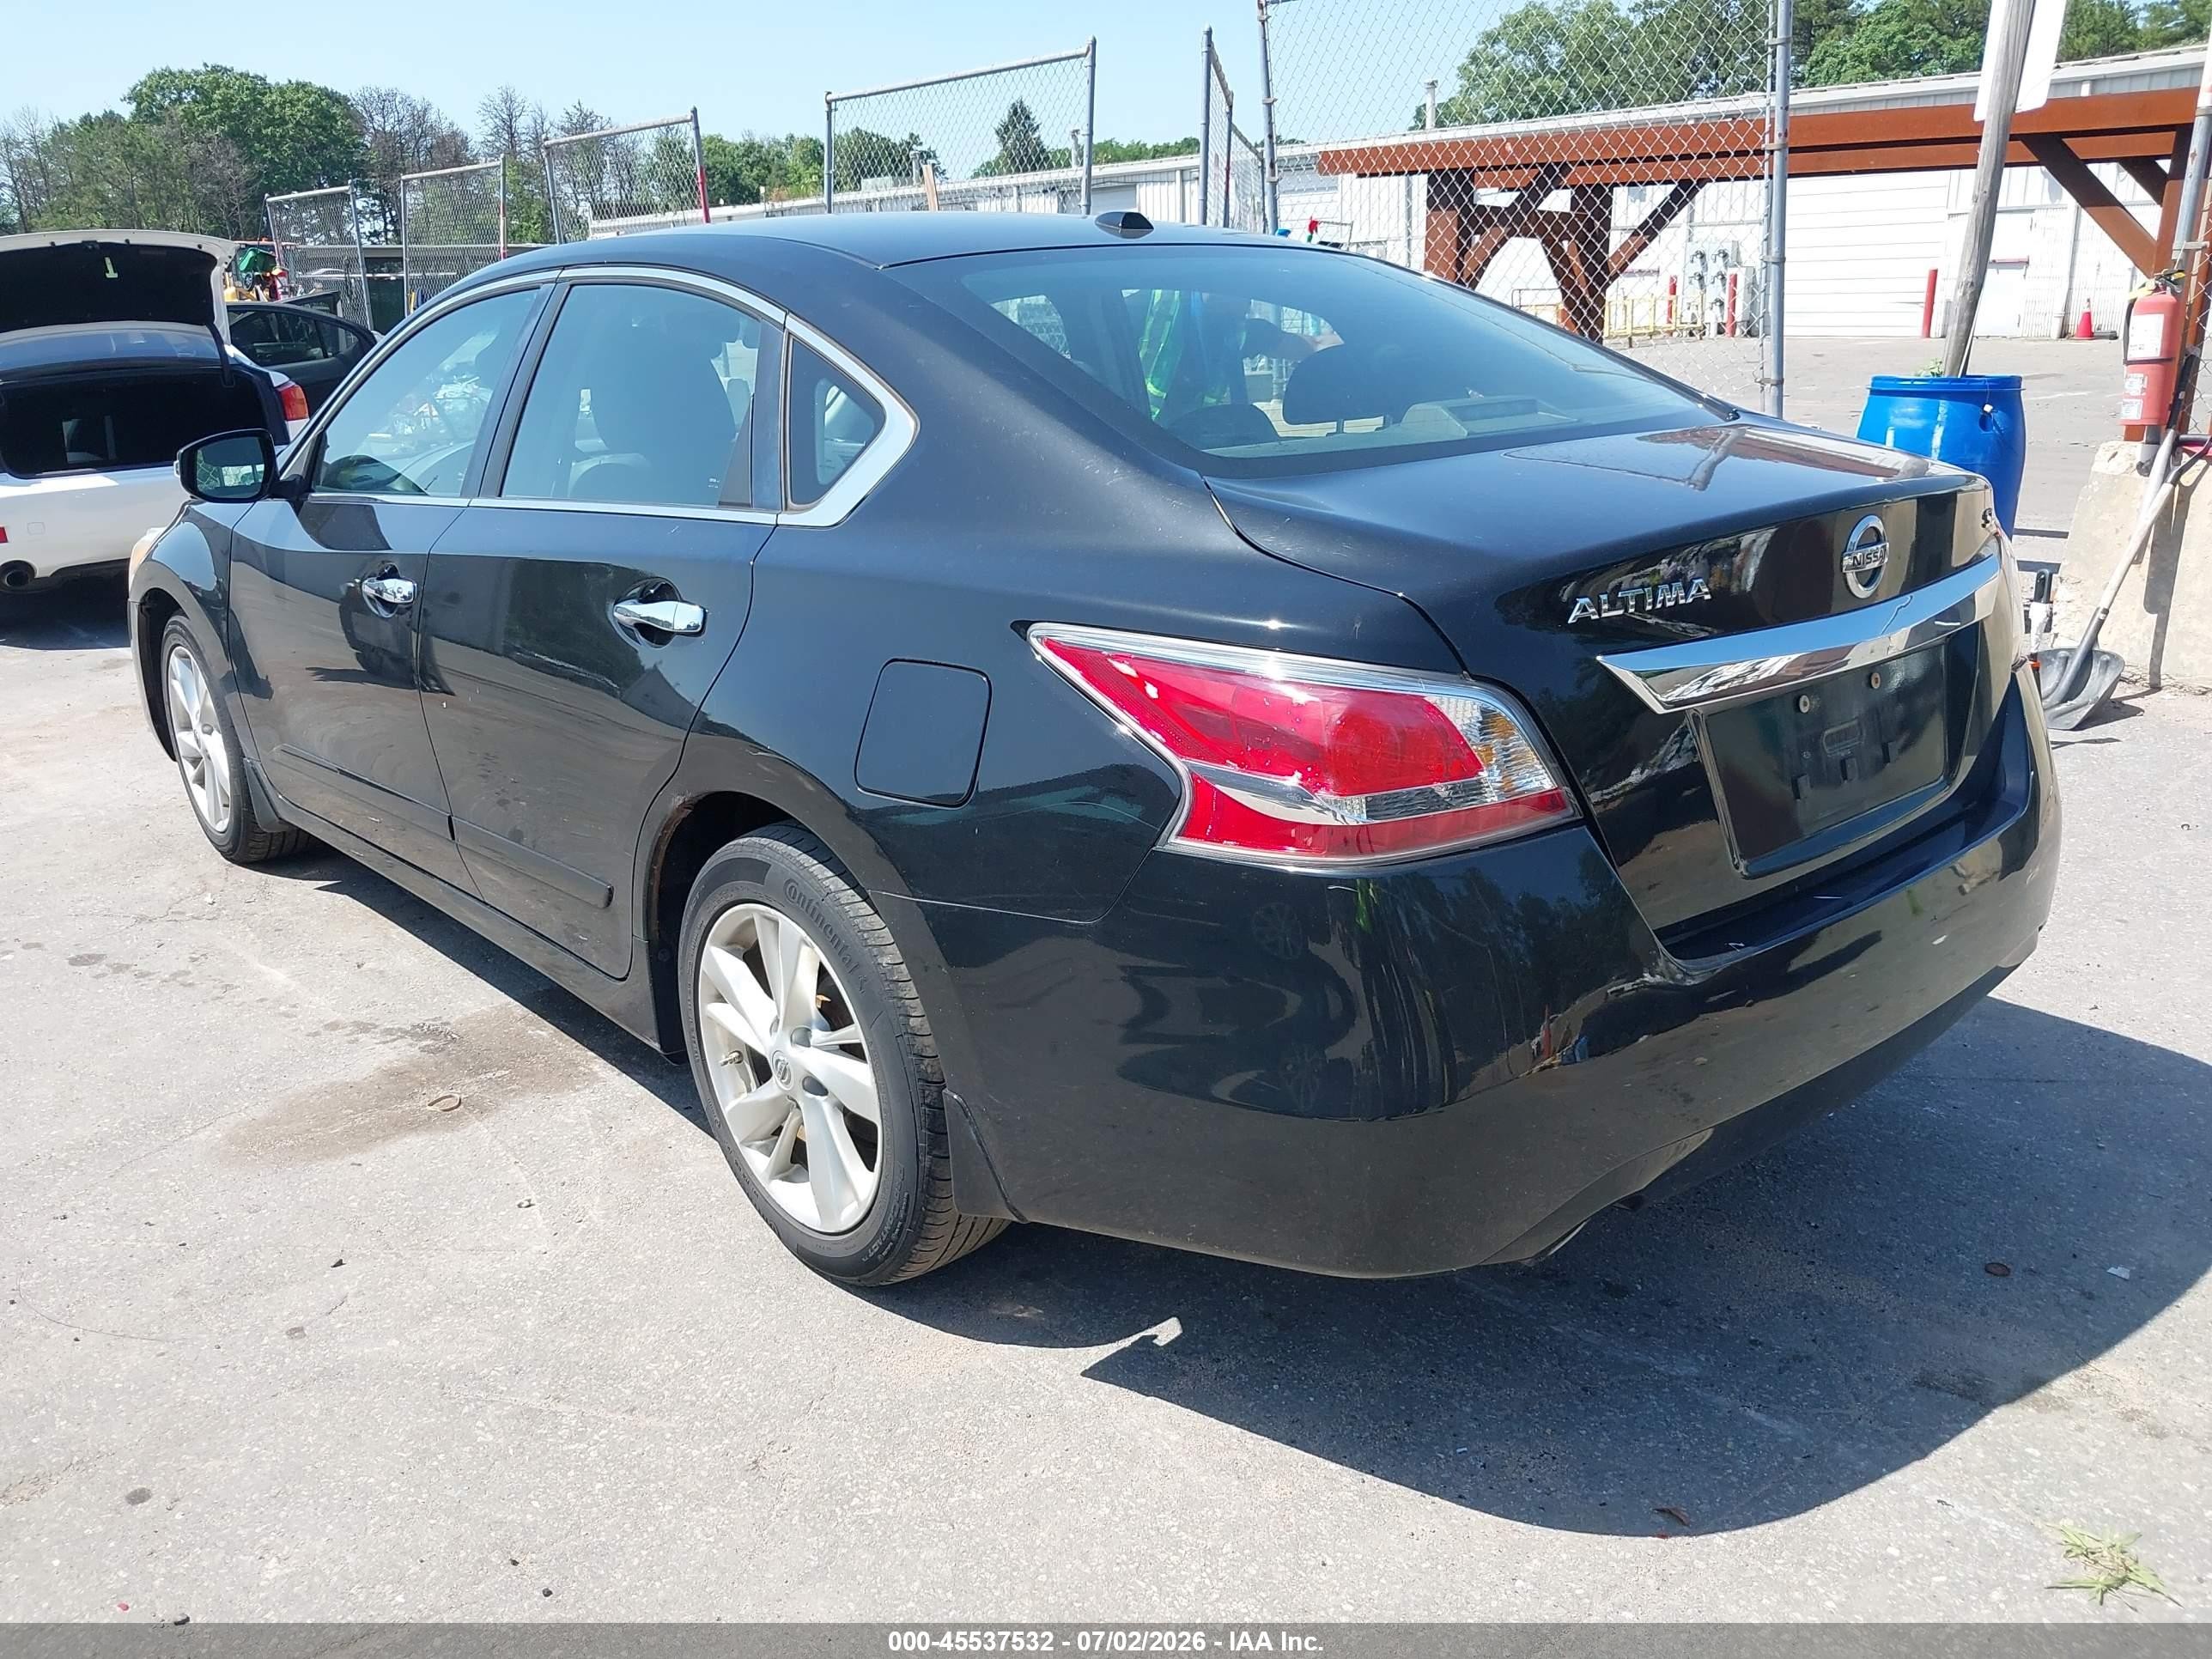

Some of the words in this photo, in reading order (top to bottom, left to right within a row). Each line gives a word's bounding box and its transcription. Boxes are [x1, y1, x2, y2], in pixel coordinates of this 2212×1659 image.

[1852, 544, 1888, 567] NISSAN
[1567, 577, 1711, 624] ALTIMA
[782, 878, 860, 974] Continental
